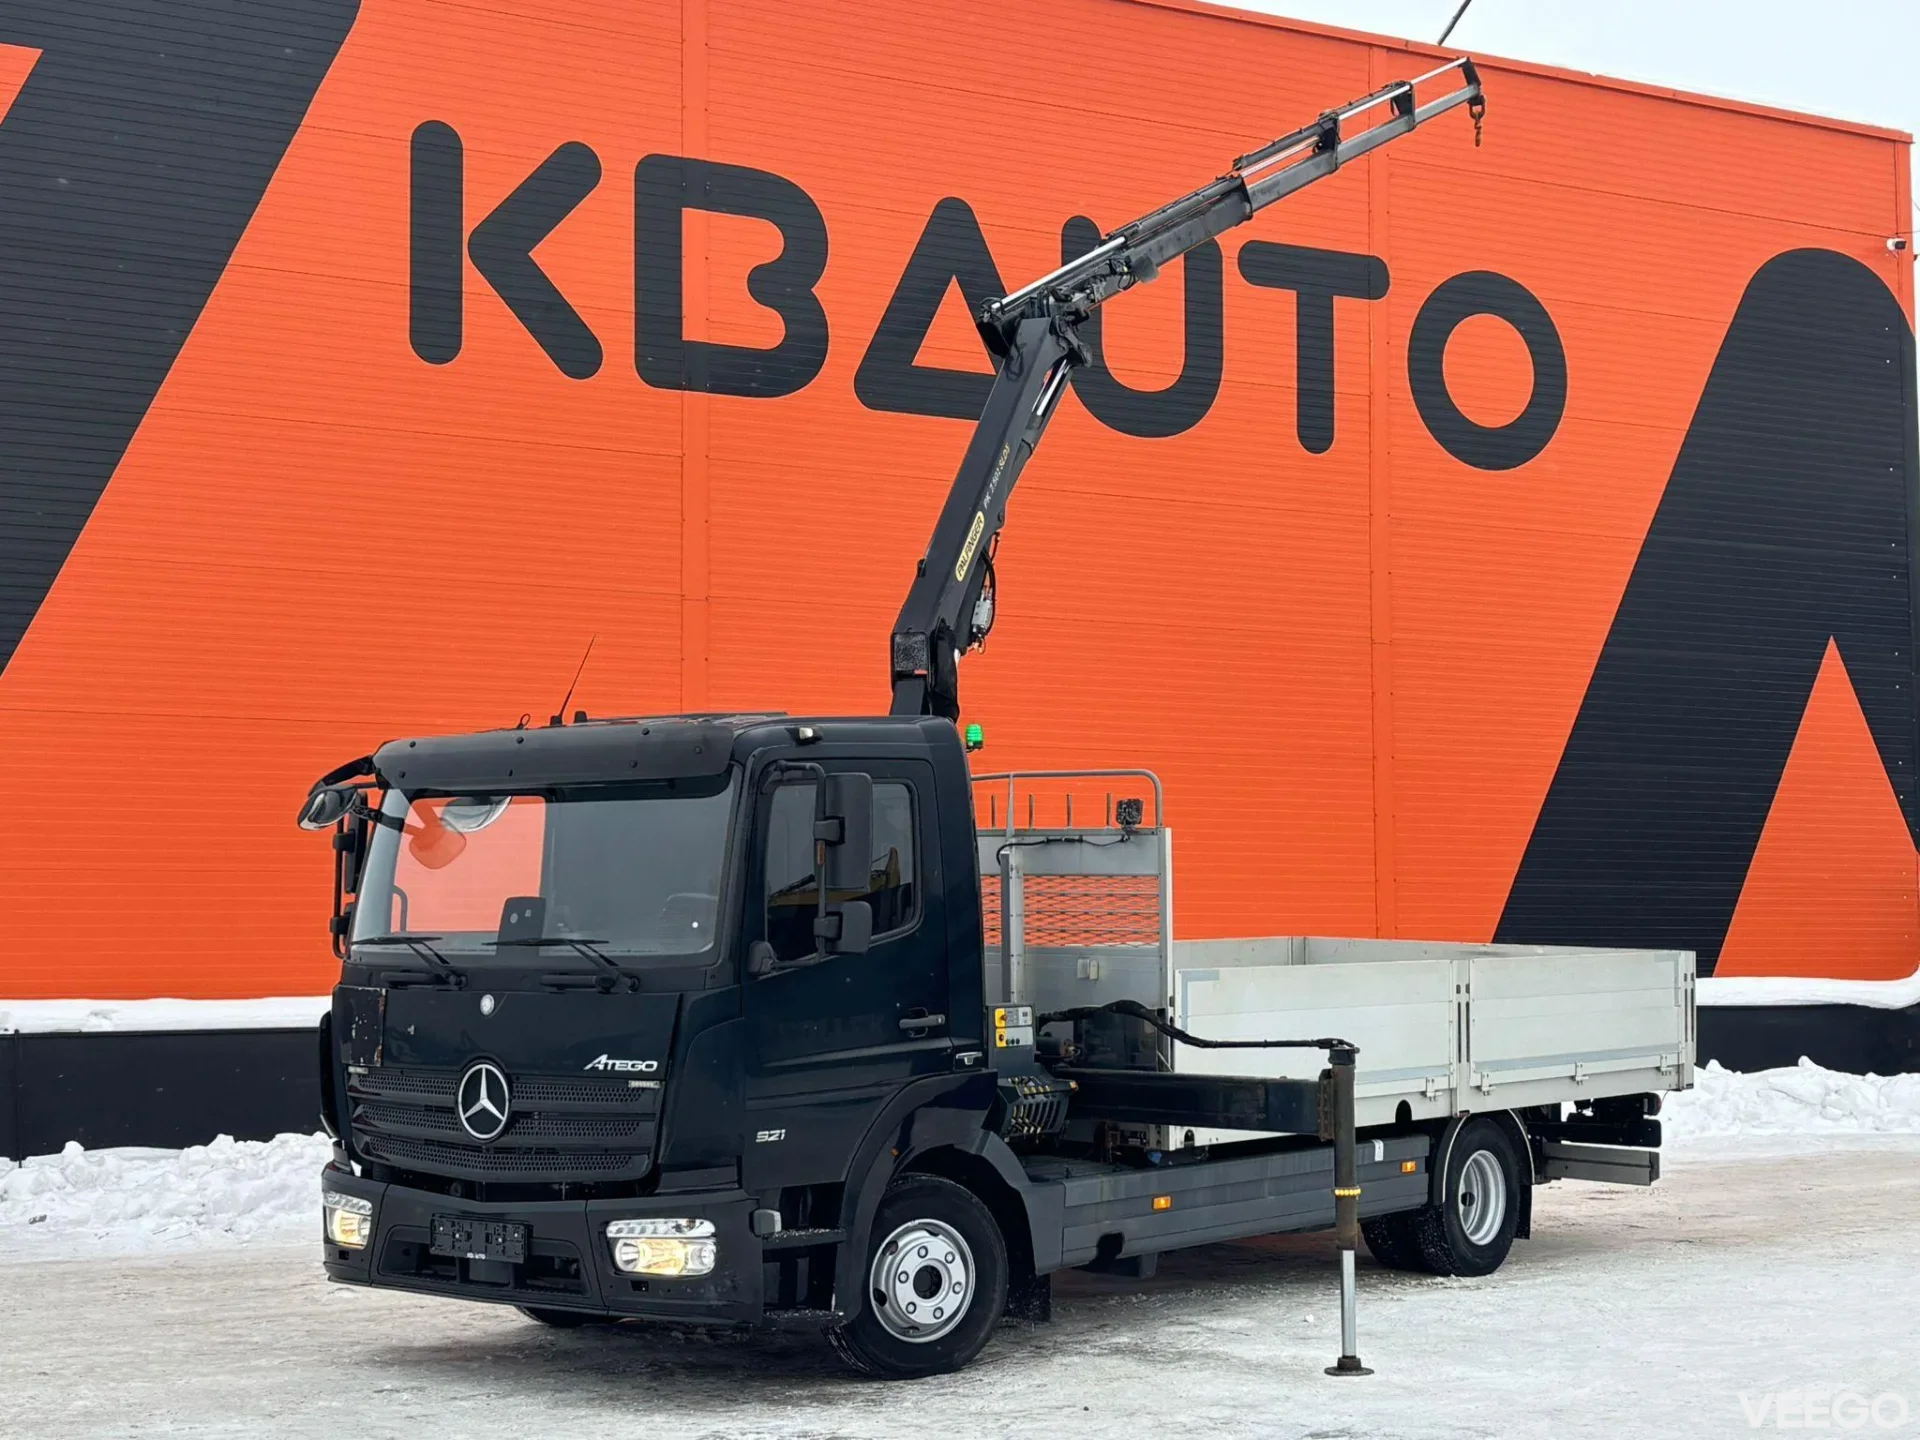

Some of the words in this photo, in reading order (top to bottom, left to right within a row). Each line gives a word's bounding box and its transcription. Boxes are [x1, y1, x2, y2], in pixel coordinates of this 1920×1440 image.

[957, 515, 984, 577] PALFINGER
[983, 491, 991, 509] PK
[583, 1053, 658, 1072] ATEGO
